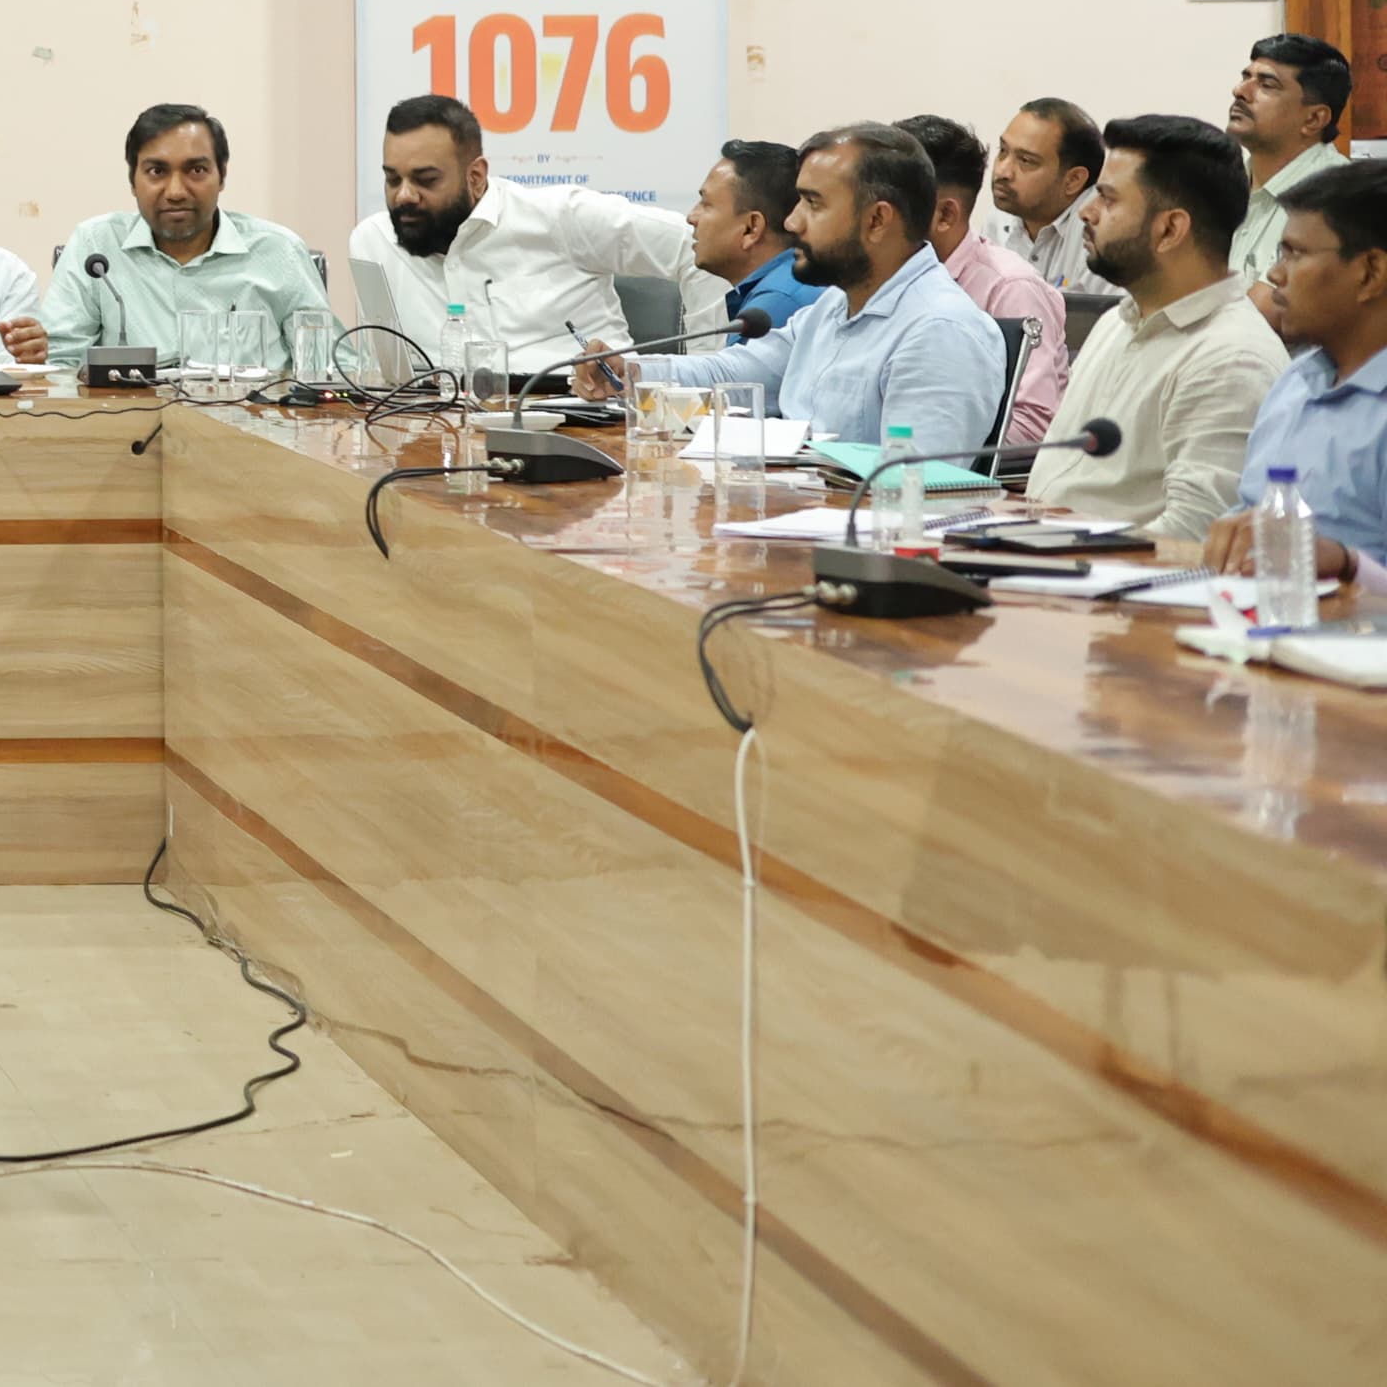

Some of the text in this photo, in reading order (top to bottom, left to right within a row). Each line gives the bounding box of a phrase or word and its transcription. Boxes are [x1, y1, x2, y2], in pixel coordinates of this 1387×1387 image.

[412, 12, 671, 133] 1076
[537, 154, 550, 163] BY
[575, 174, 589, 185] OF
